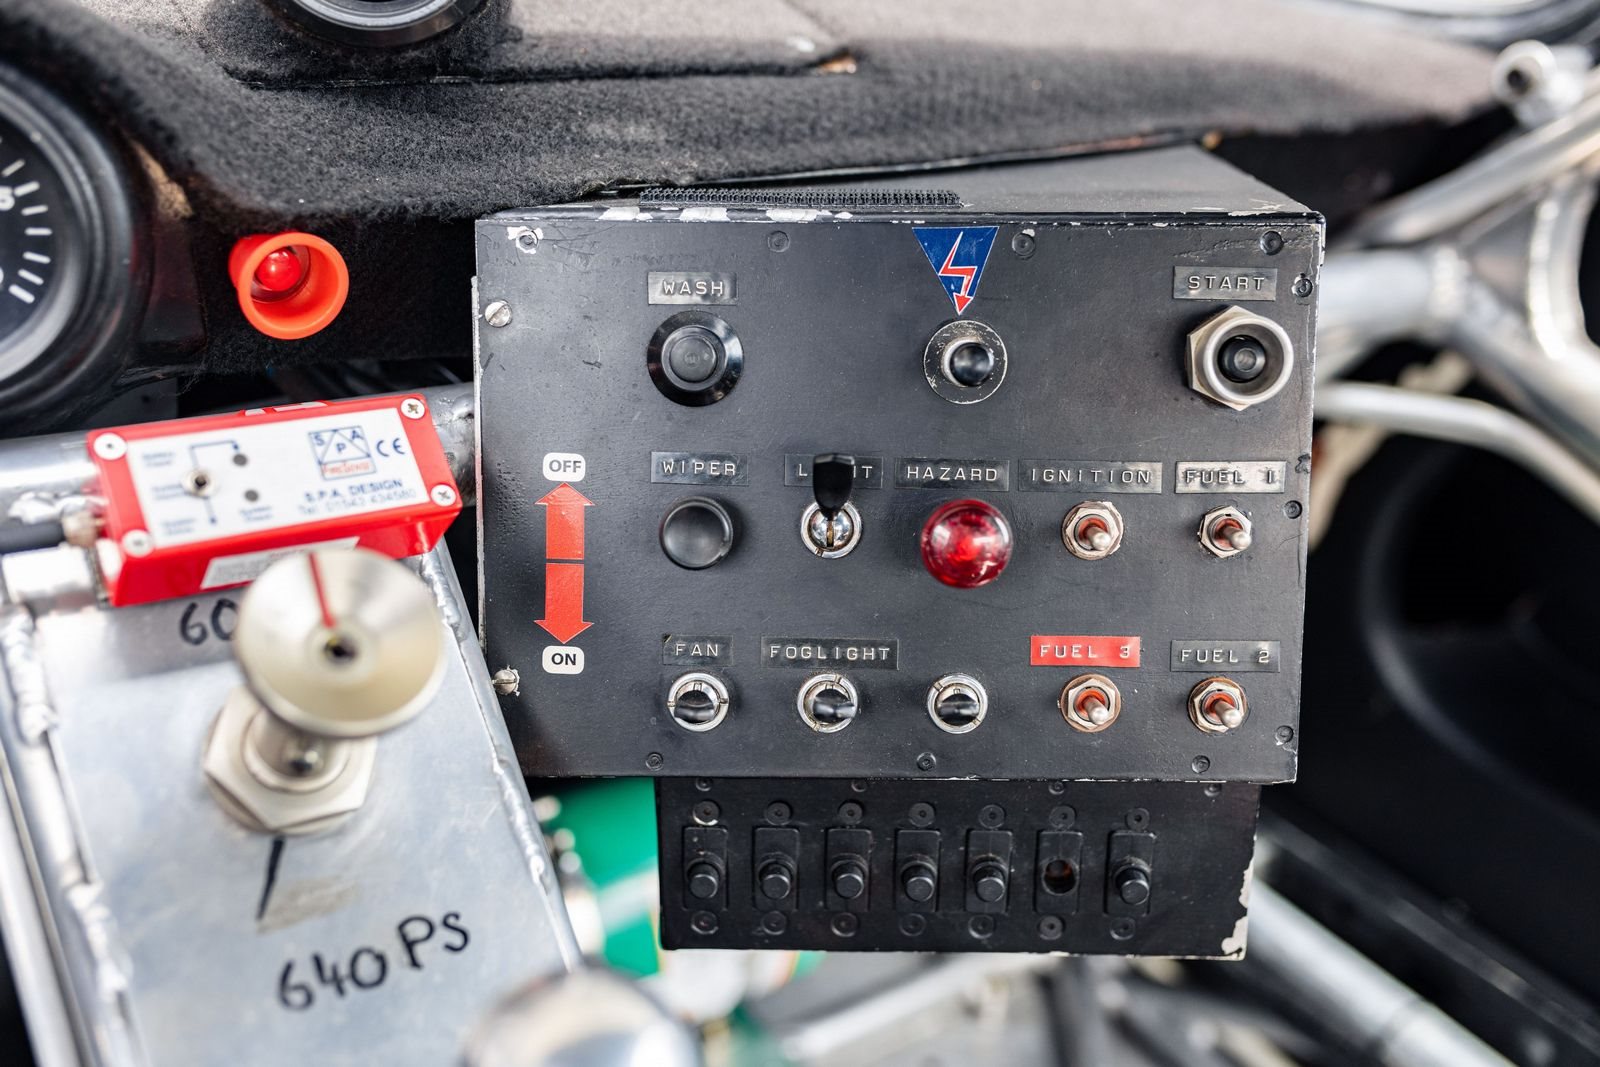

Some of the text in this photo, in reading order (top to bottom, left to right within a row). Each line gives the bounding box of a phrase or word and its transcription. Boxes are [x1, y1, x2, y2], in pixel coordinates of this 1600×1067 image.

[663, 279, 724, 296] WASH
[1188, 275, 1265, 291] START
[548, 459, 582, 473] OFF
[663, 461, 736, 477] WIPER
[906, 466, 998, 482] HAZARD
[1031, 469, 1151, 484] IGNITION
[1186, 470, 1244, 484] FUEL
[348, 479, 403, 496] DESIGN
[674, 643, 719, 657] FAN
[770, 645, 890, 661] FOGLIGHT
[1040, 644, 1131, 659] FUEL 3
[1180, 649, 1270, 664] FUEL 2
[551, 653, 577, 666] ON
[278, 911, 470, 1012] 640 PS
